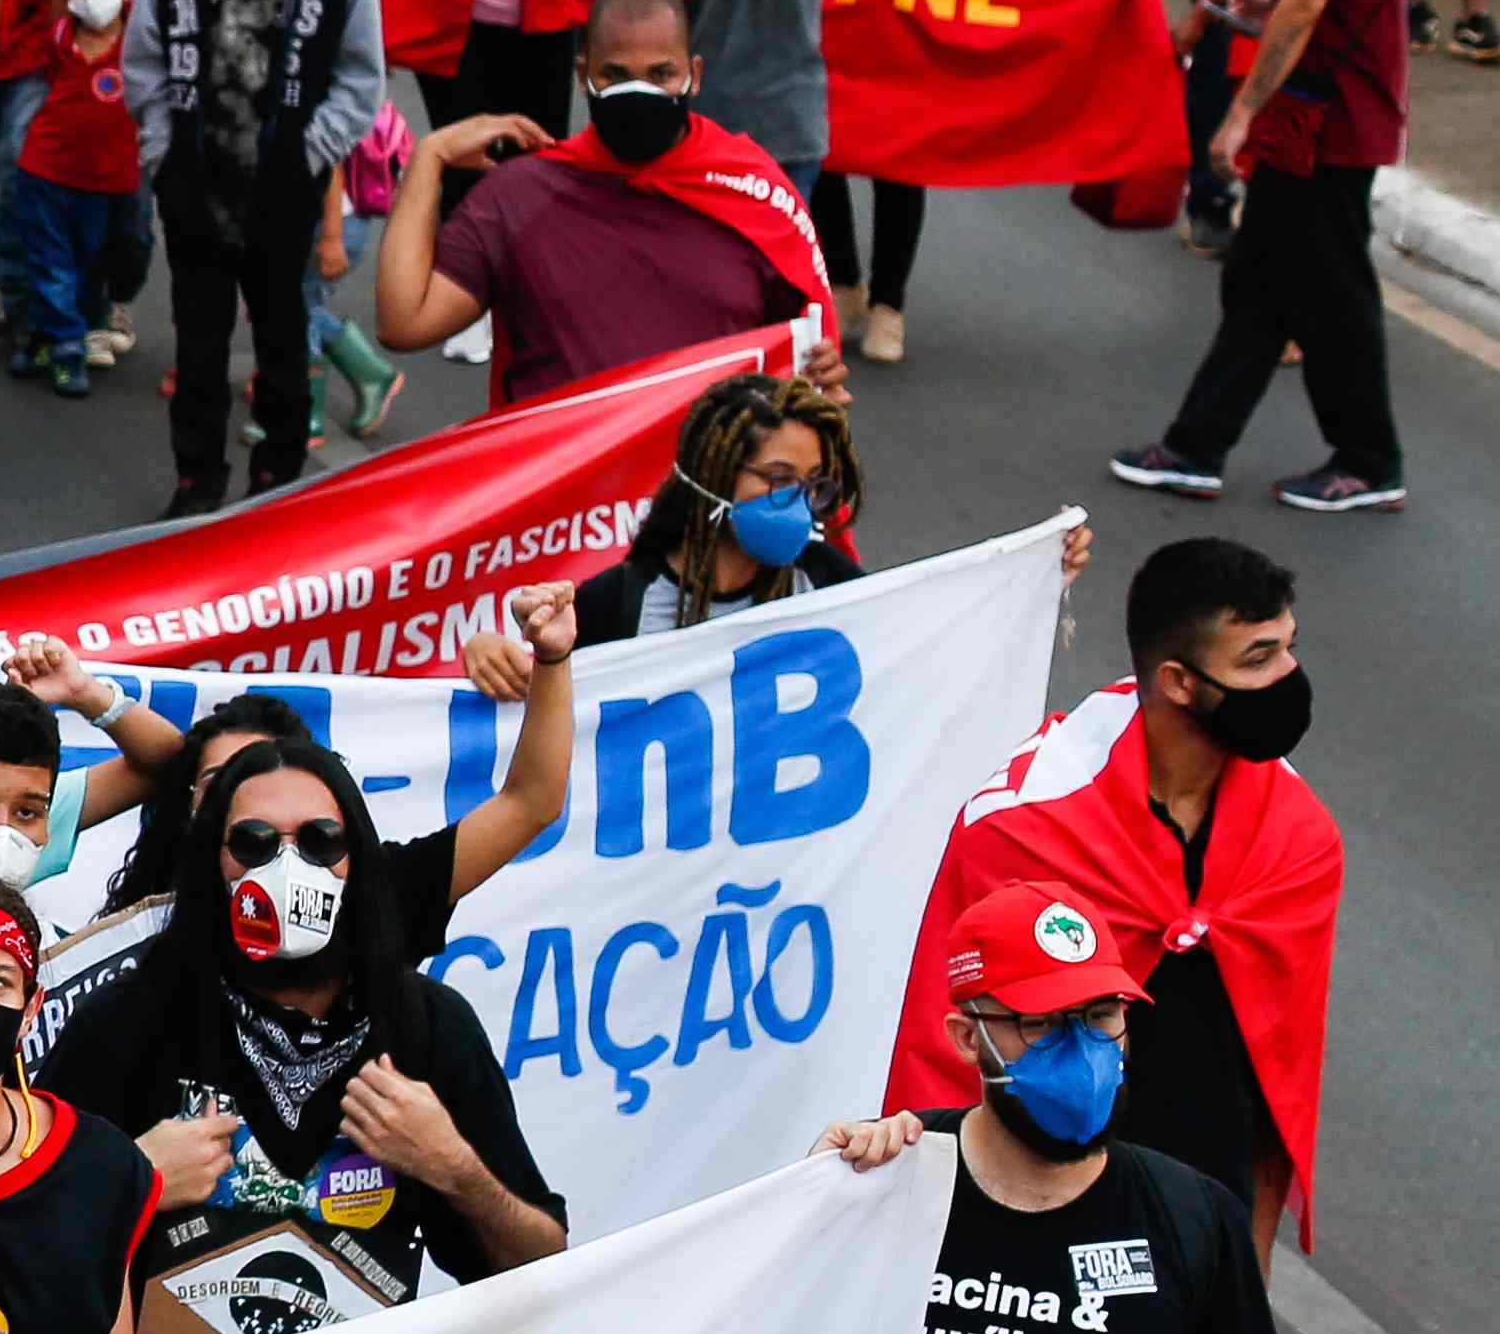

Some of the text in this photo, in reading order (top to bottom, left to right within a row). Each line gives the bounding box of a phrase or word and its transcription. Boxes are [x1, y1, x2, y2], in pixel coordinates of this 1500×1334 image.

[79, 621, 110, 652] O
[123, 563, 375, 648] GENOCÍDIO
[386, 559, 412, 601] E
[425, 551, 452, 591] O
[463, 497, 655, 581] FASCISM
[291, 883, 326, 918] FORA
[329, 1165, 384, 1194] FORA
[1071, 1247, 1133, 1280] FORA
[1097, 1272, 1155, 1289] BOLSONARO
[177, 1278, 261, 1304] DESORDEM
[293, 1286, 348, 1324] REGRE
[928, 1271, 1109, 1333] acina &
